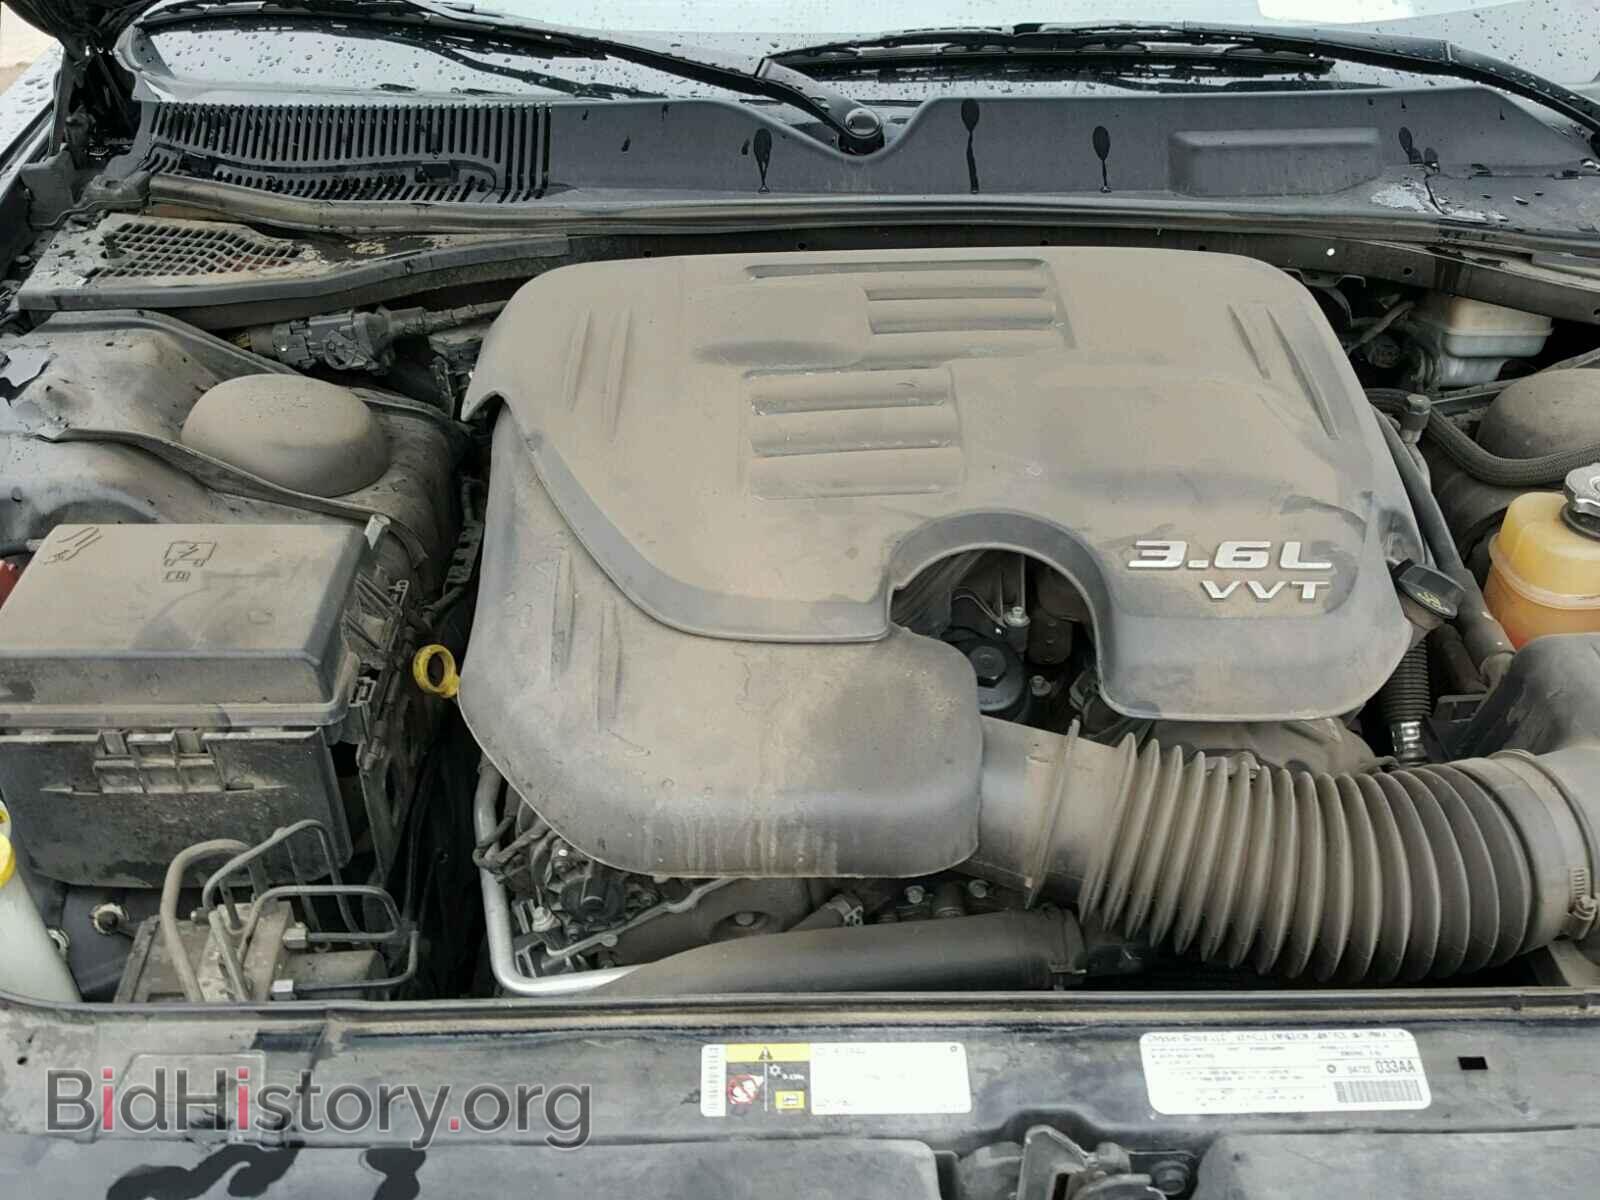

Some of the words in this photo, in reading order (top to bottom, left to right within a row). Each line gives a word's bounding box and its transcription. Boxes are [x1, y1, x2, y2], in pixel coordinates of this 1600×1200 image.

[1128, 540, 1333, 569] 3.6L
[1200, 580, 1332, 600] VVT
[1376, 1060, 1416, 1073] 033AA
